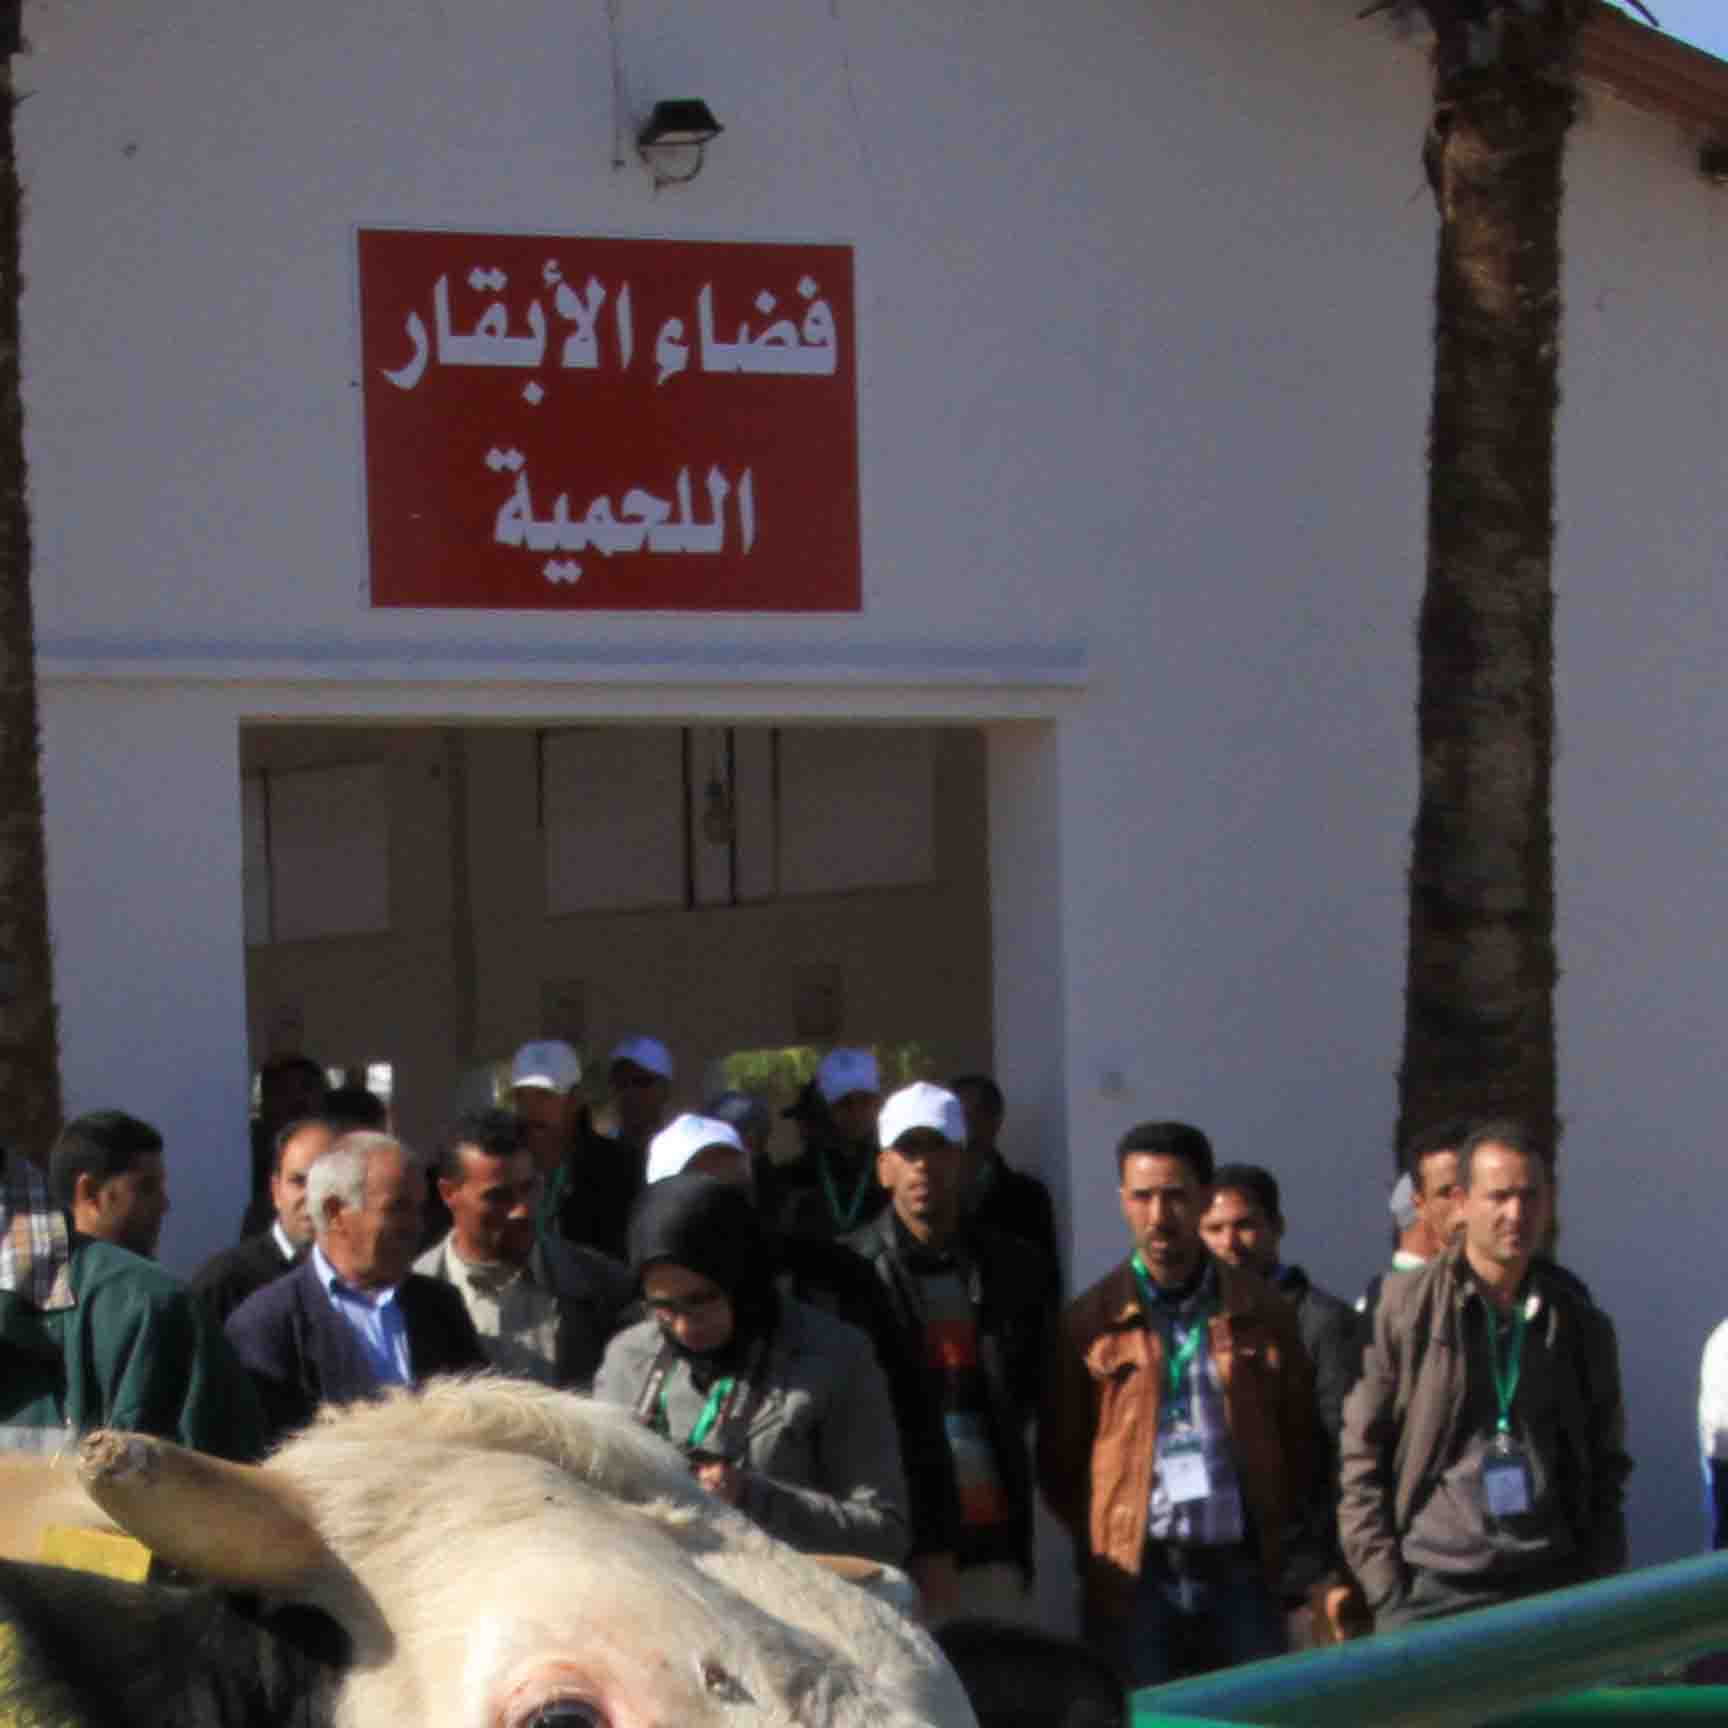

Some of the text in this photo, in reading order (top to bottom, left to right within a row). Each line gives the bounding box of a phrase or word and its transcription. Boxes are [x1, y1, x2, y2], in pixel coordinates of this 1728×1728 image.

[382, 258, 836, 405] فضاء الأبقار
[484, 446, 755, 585] اللحمية
